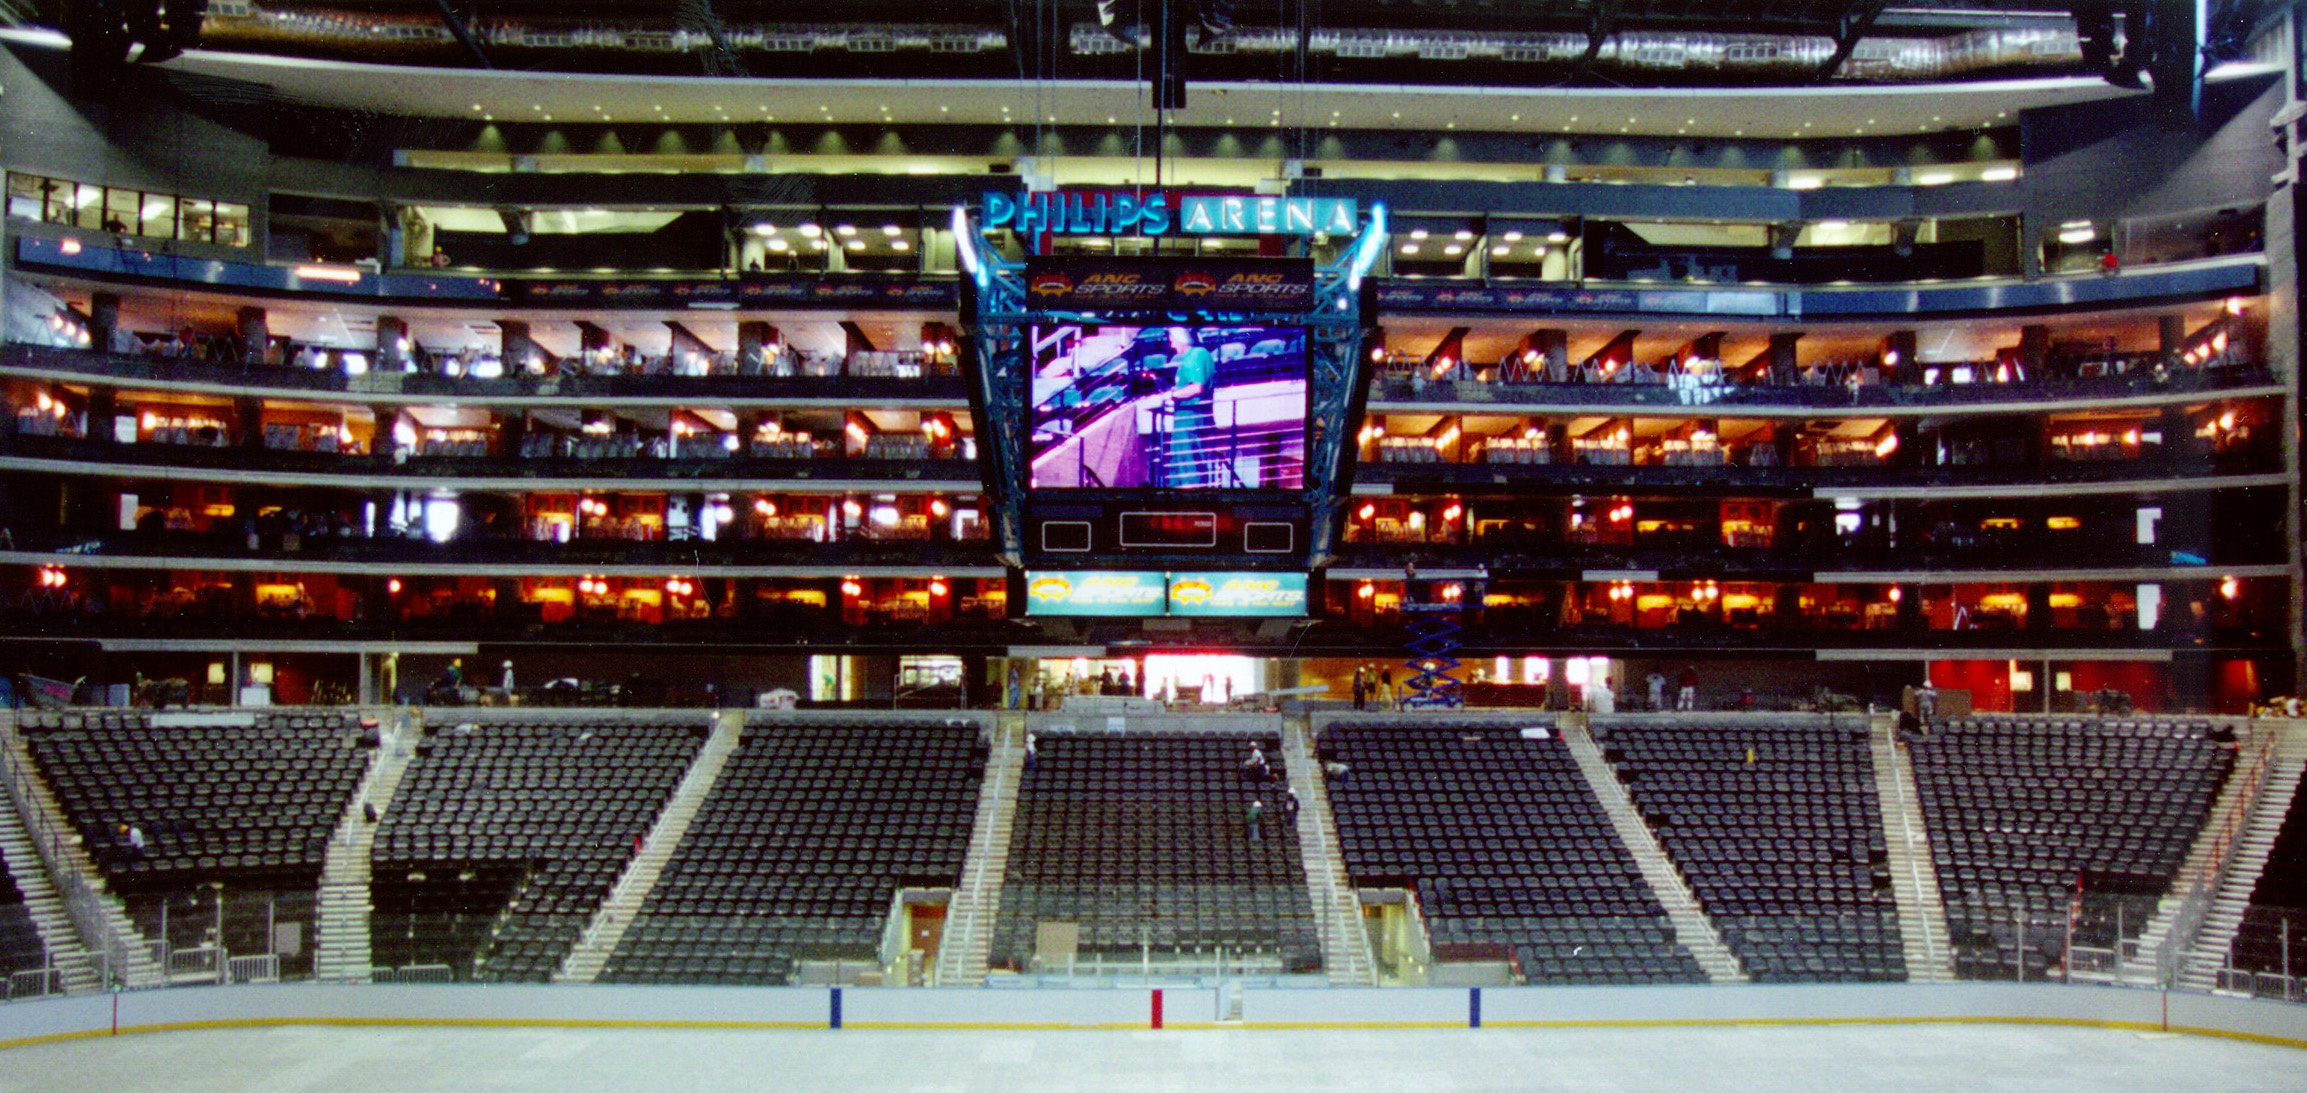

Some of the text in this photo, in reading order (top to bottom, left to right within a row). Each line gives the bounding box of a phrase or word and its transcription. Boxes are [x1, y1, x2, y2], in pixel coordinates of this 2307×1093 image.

[982, 192, 1354, 234] PHILIPS ARENA
[1074, 283, 1166, 294] SPORTS
[1218, 283, 1308, 294] SPORTS
